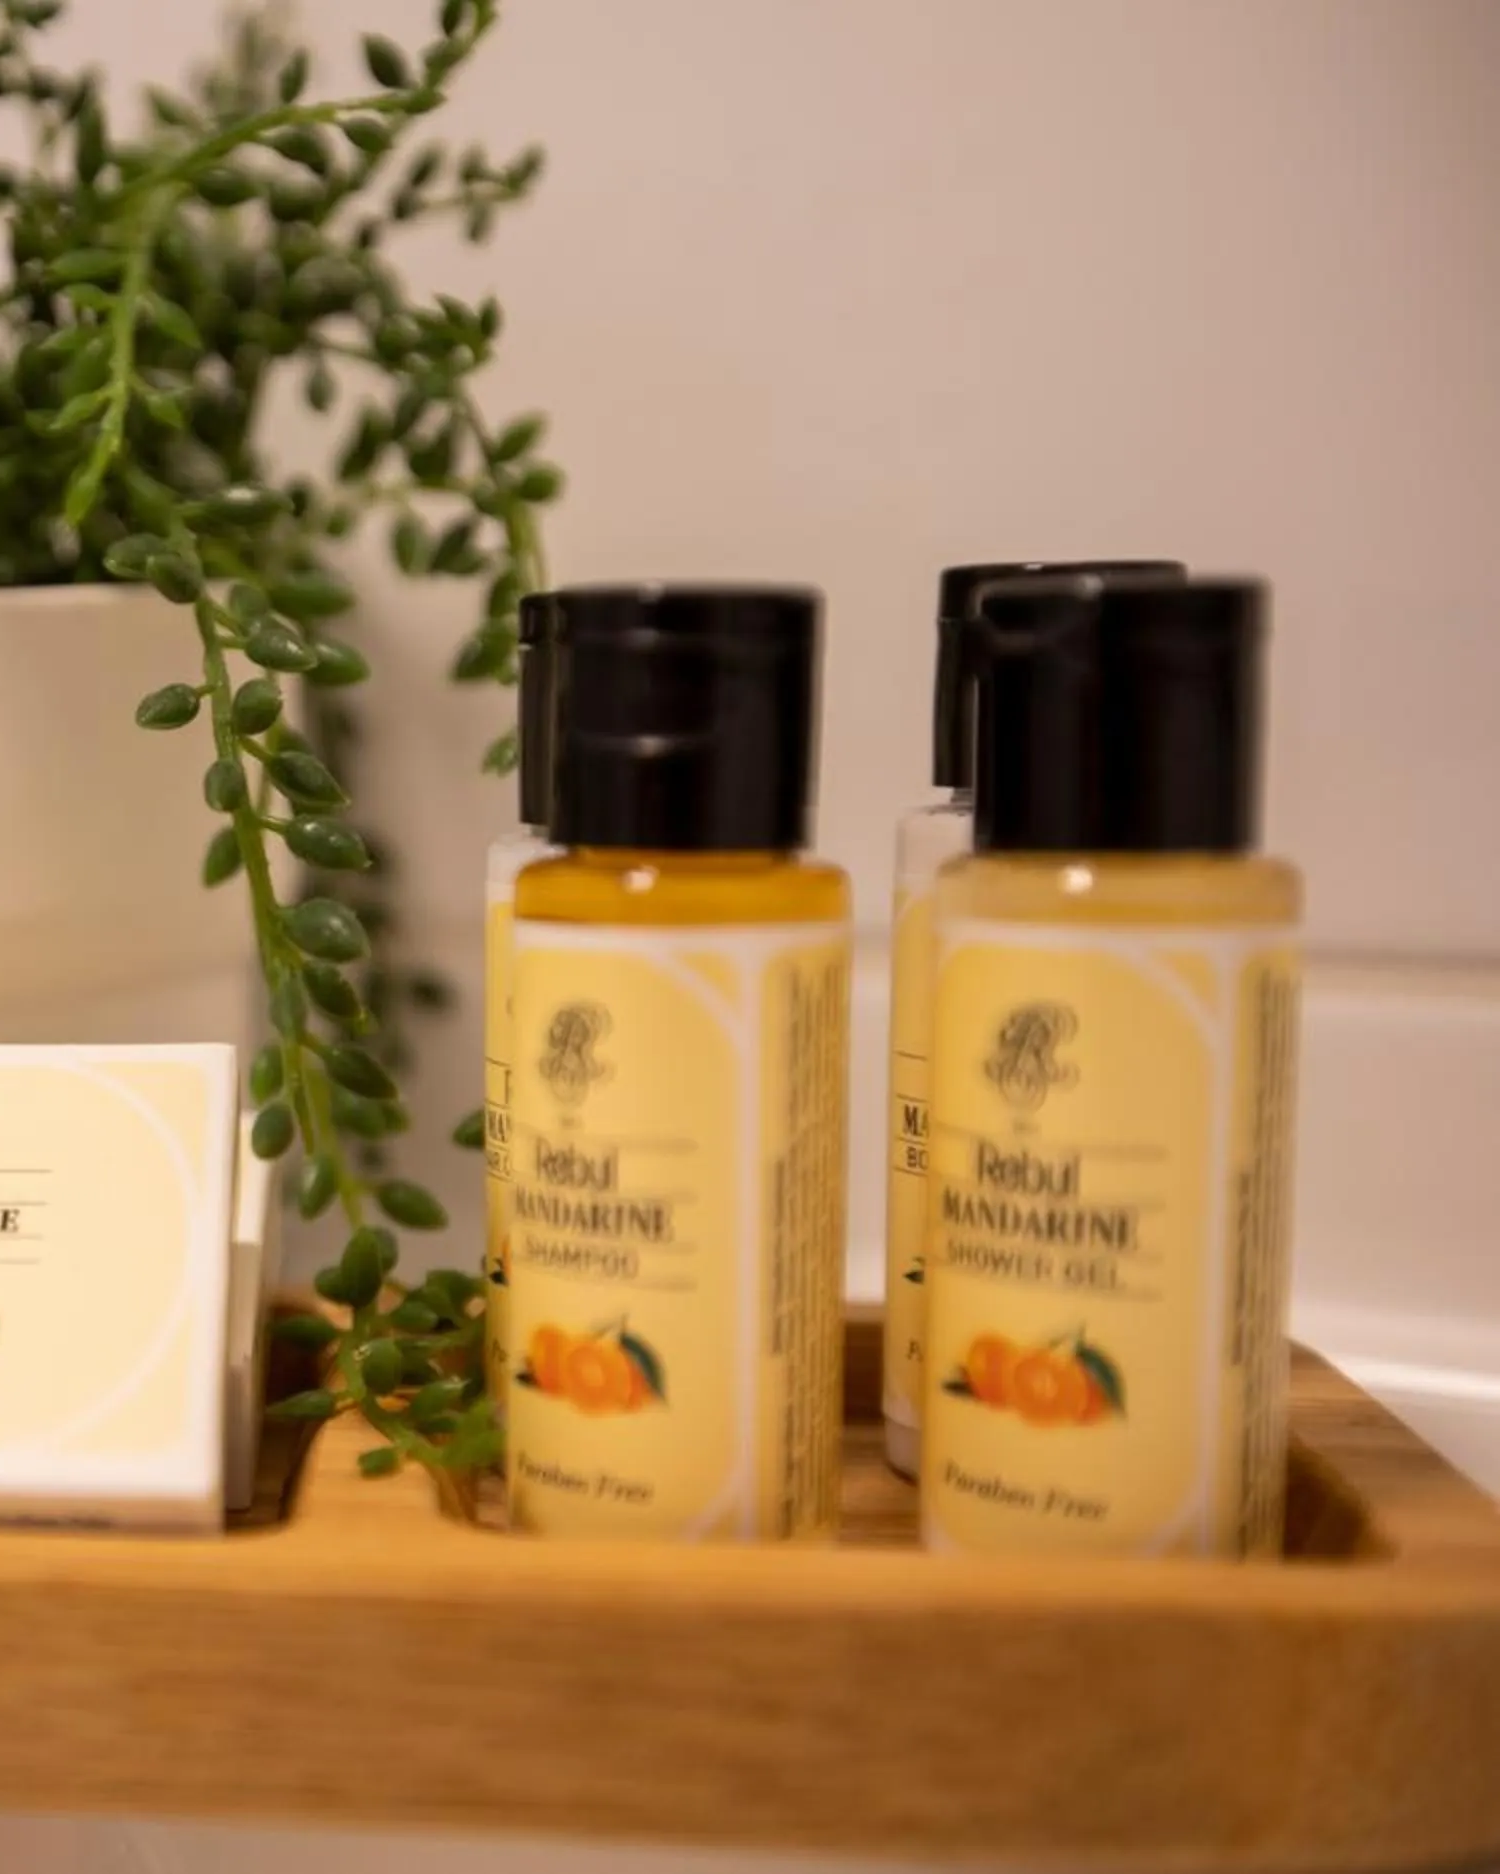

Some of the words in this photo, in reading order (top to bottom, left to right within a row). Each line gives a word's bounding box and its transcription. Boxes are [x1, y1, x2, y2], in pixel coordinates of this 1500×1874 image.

[536, 1135, 619, 1192] Rebul
[976, 1140, 1081, 1198] Rebul
[515, 1184, 674, 1244] MANDARINE
[942, 1185, 1140, 1252] MANDARINE
[526, 1234, 640, 1279] SHAMPOO
[947, 1239, 1054, 1281] SHOWER
[1064, 1256, 1126, 1290] GEL
[944, 1458, 1035, 1507] Paraben
